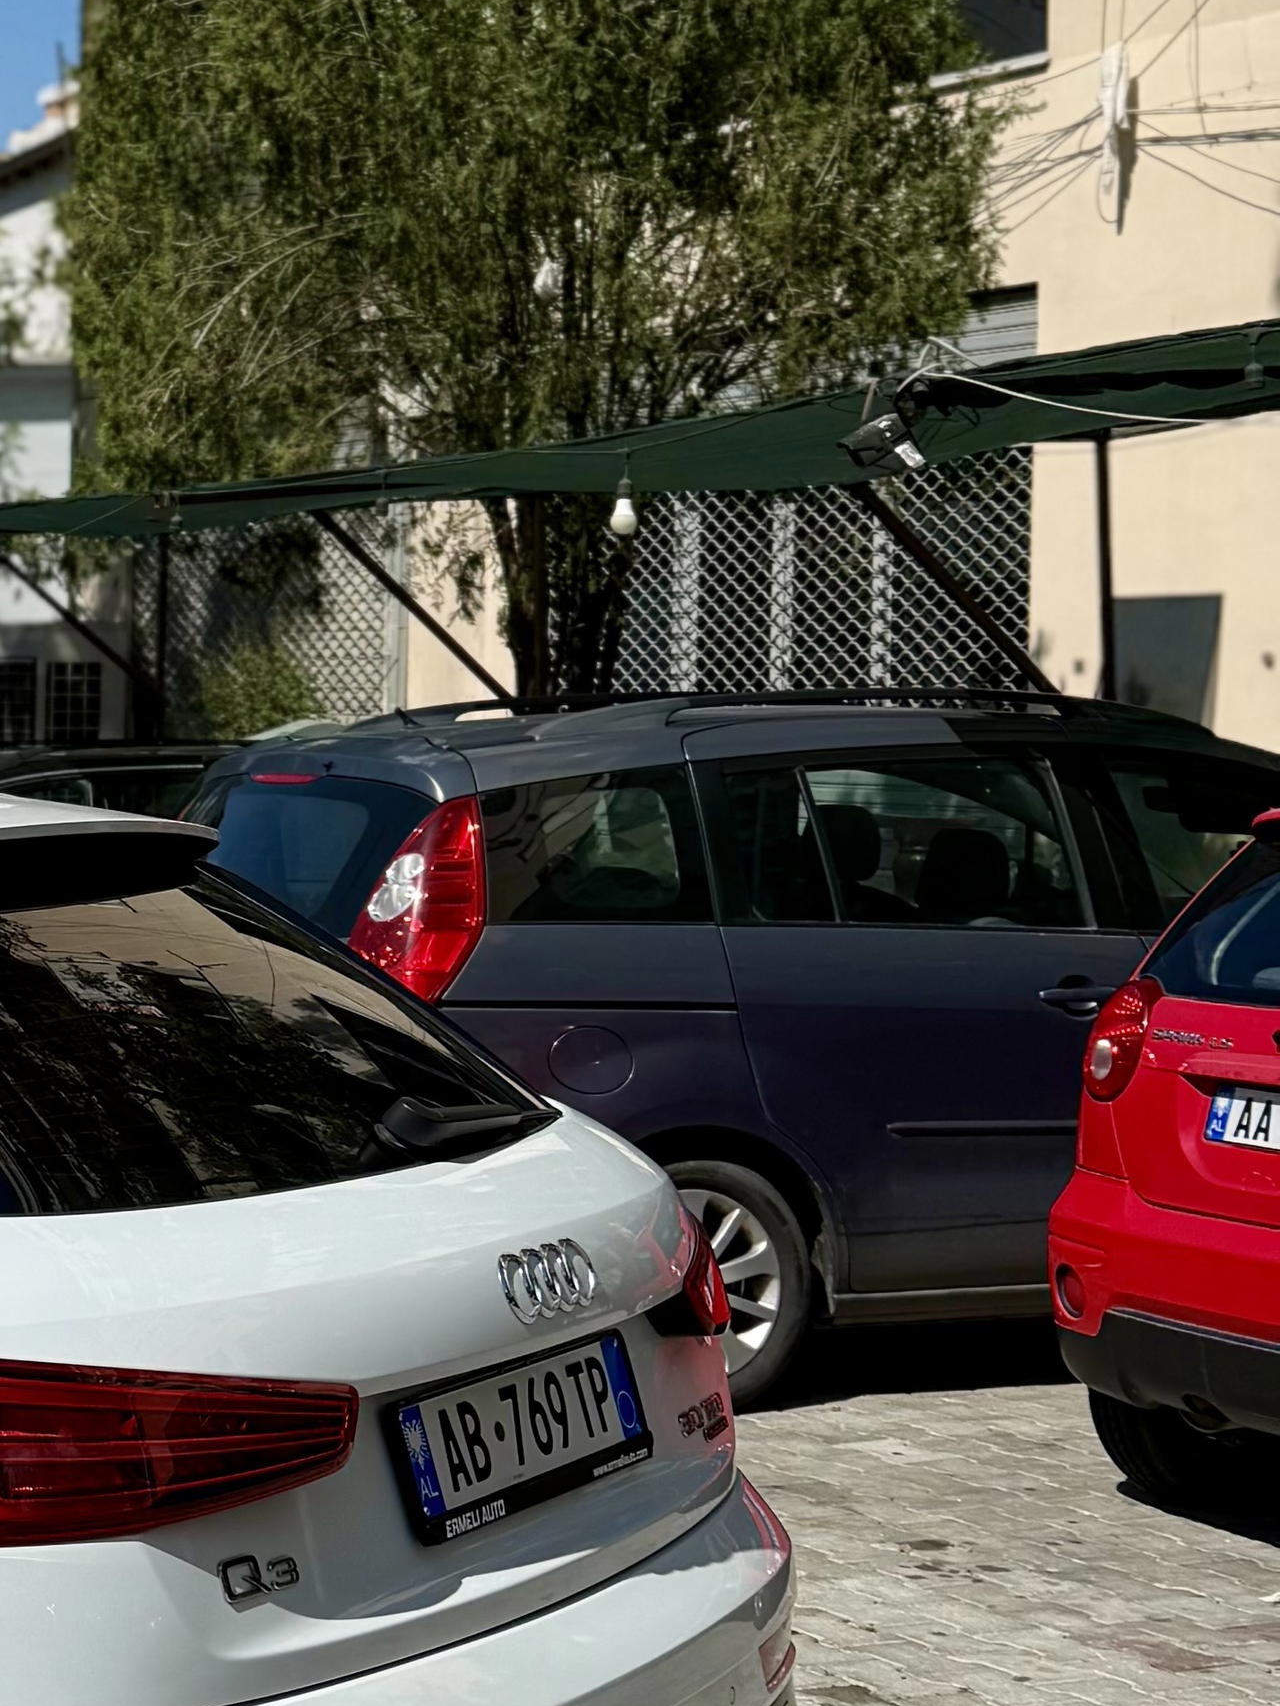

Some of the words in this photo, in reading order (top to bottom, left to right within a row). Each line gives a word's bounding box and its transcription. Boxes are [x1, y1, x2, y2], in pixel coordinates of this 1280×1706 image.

[1233, 1096, 1273, 1142] AA
[419, 1475, 440, 1502] AL
[445, 1509, 481, 1539] ERMELI
[481, 1499, 506, 1524] AUTO
[217, 1554, 300, 1604] Q3
